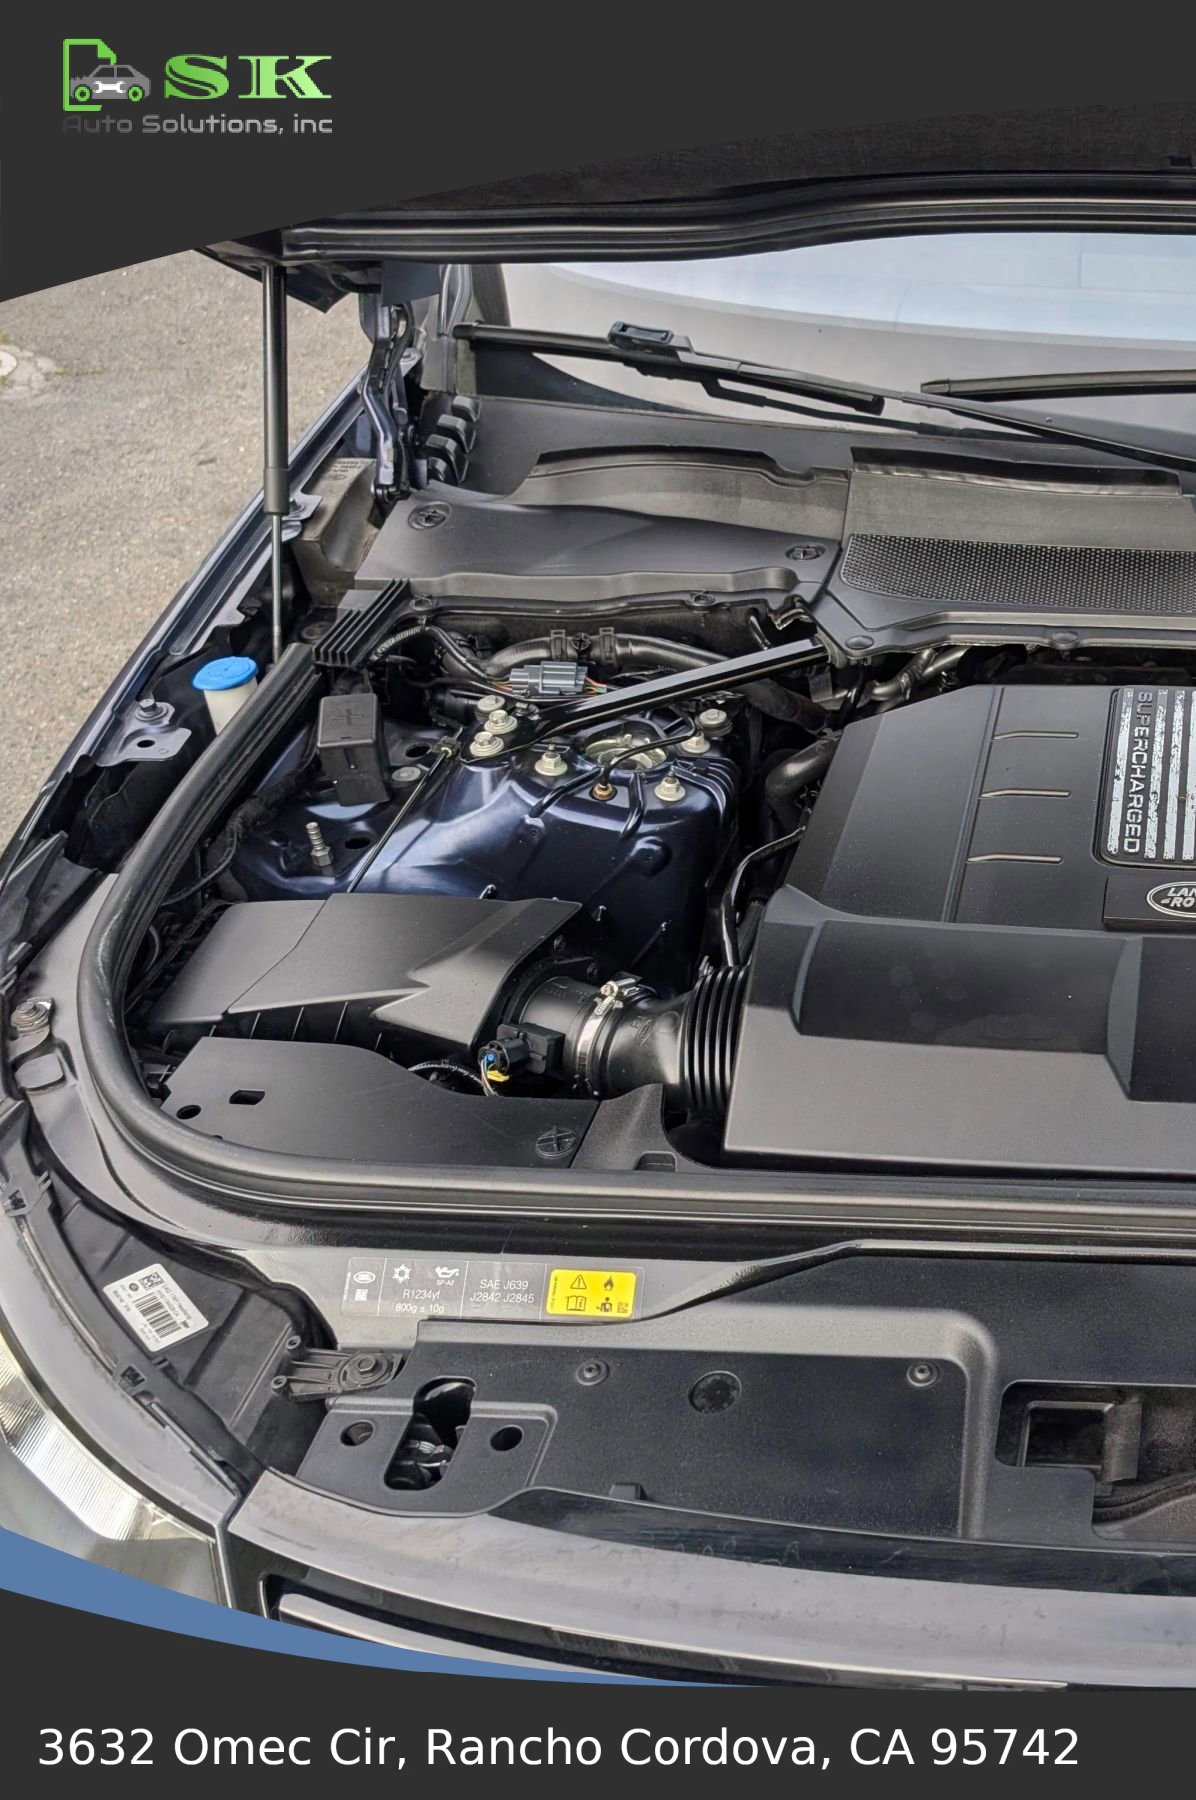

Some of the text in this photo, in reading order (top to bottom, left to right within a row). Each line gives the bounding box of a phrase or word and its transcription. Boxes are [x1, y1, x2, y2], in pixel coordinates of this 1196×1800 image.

[1123, 691, 1153, 853] SUPERCHARGED
[479, 1279, 529, 1290] SAE J639
[470, 1292, 535, 1304] J2842 J2845
[395, 1302, 417, 1314] 800g
[429, 1303, 445, 1314] 10g
